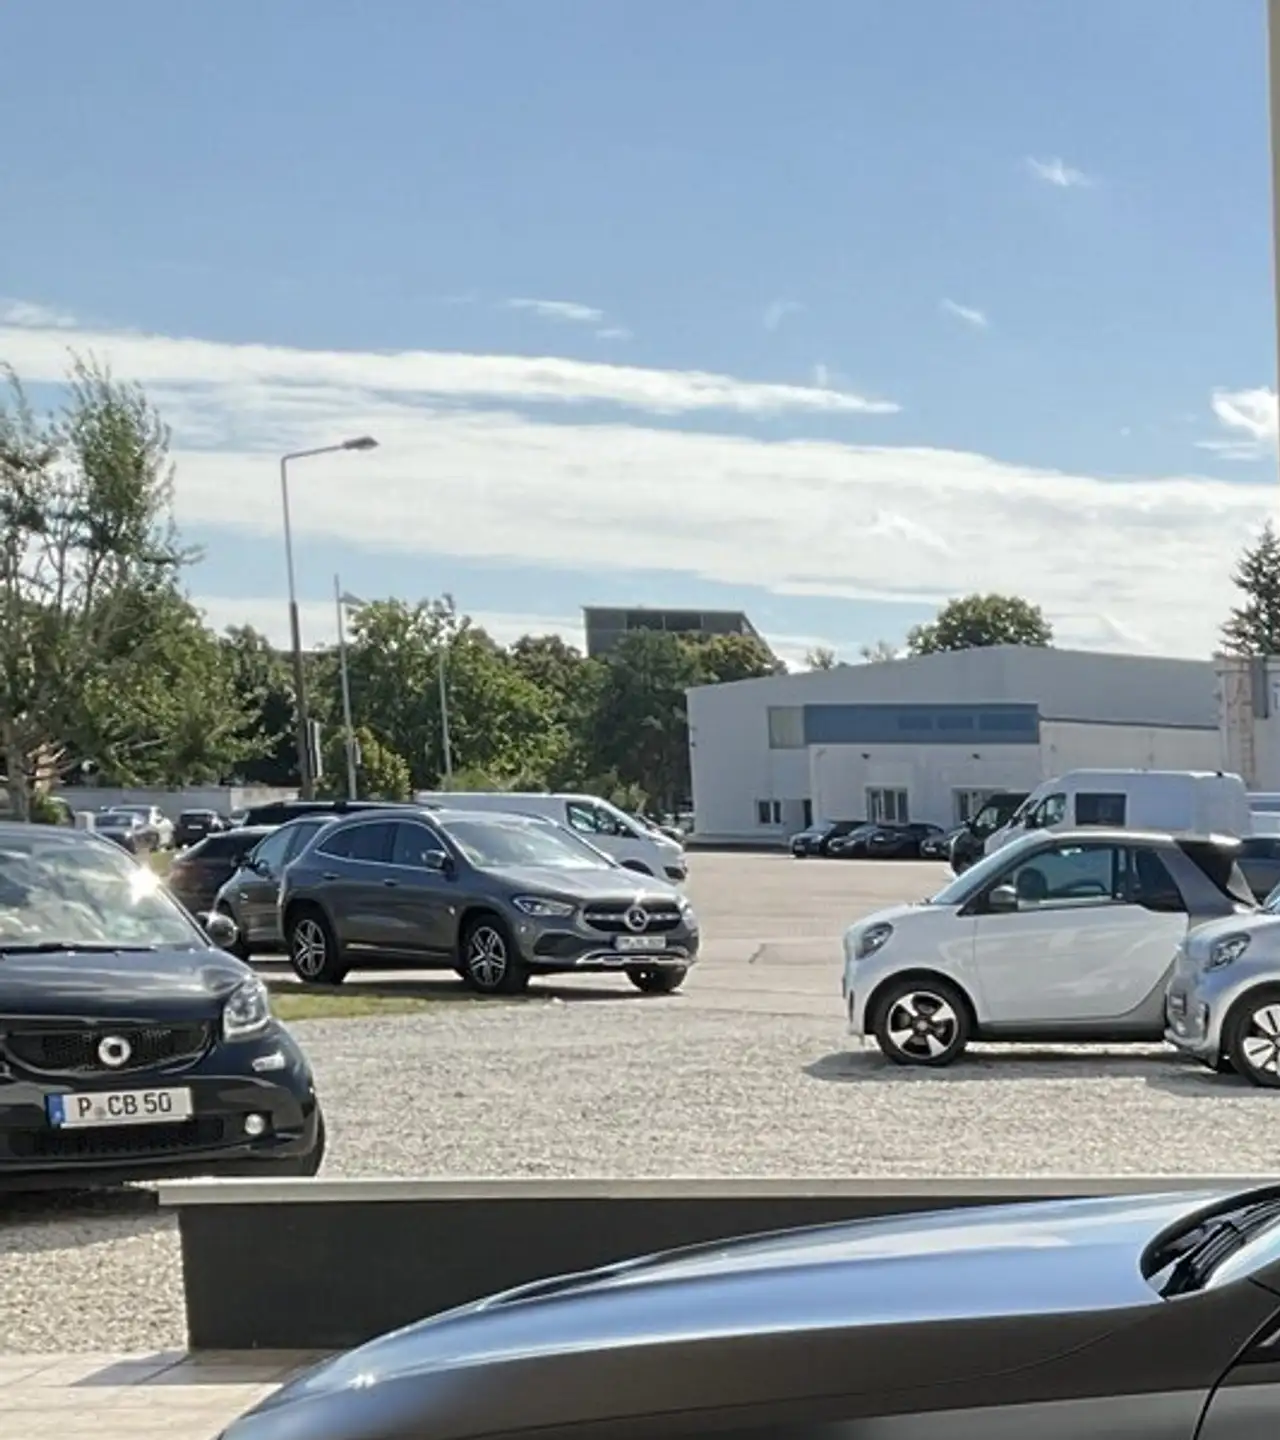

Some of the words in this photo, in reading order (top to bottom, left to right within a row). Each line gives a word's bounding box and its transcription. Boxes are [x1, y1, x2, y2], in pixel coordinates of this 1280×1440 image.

[77, 1096, 92, 1117] P
[107, 1094, 138, 1116] CB
[143, 1092, 171, 1113] 50
